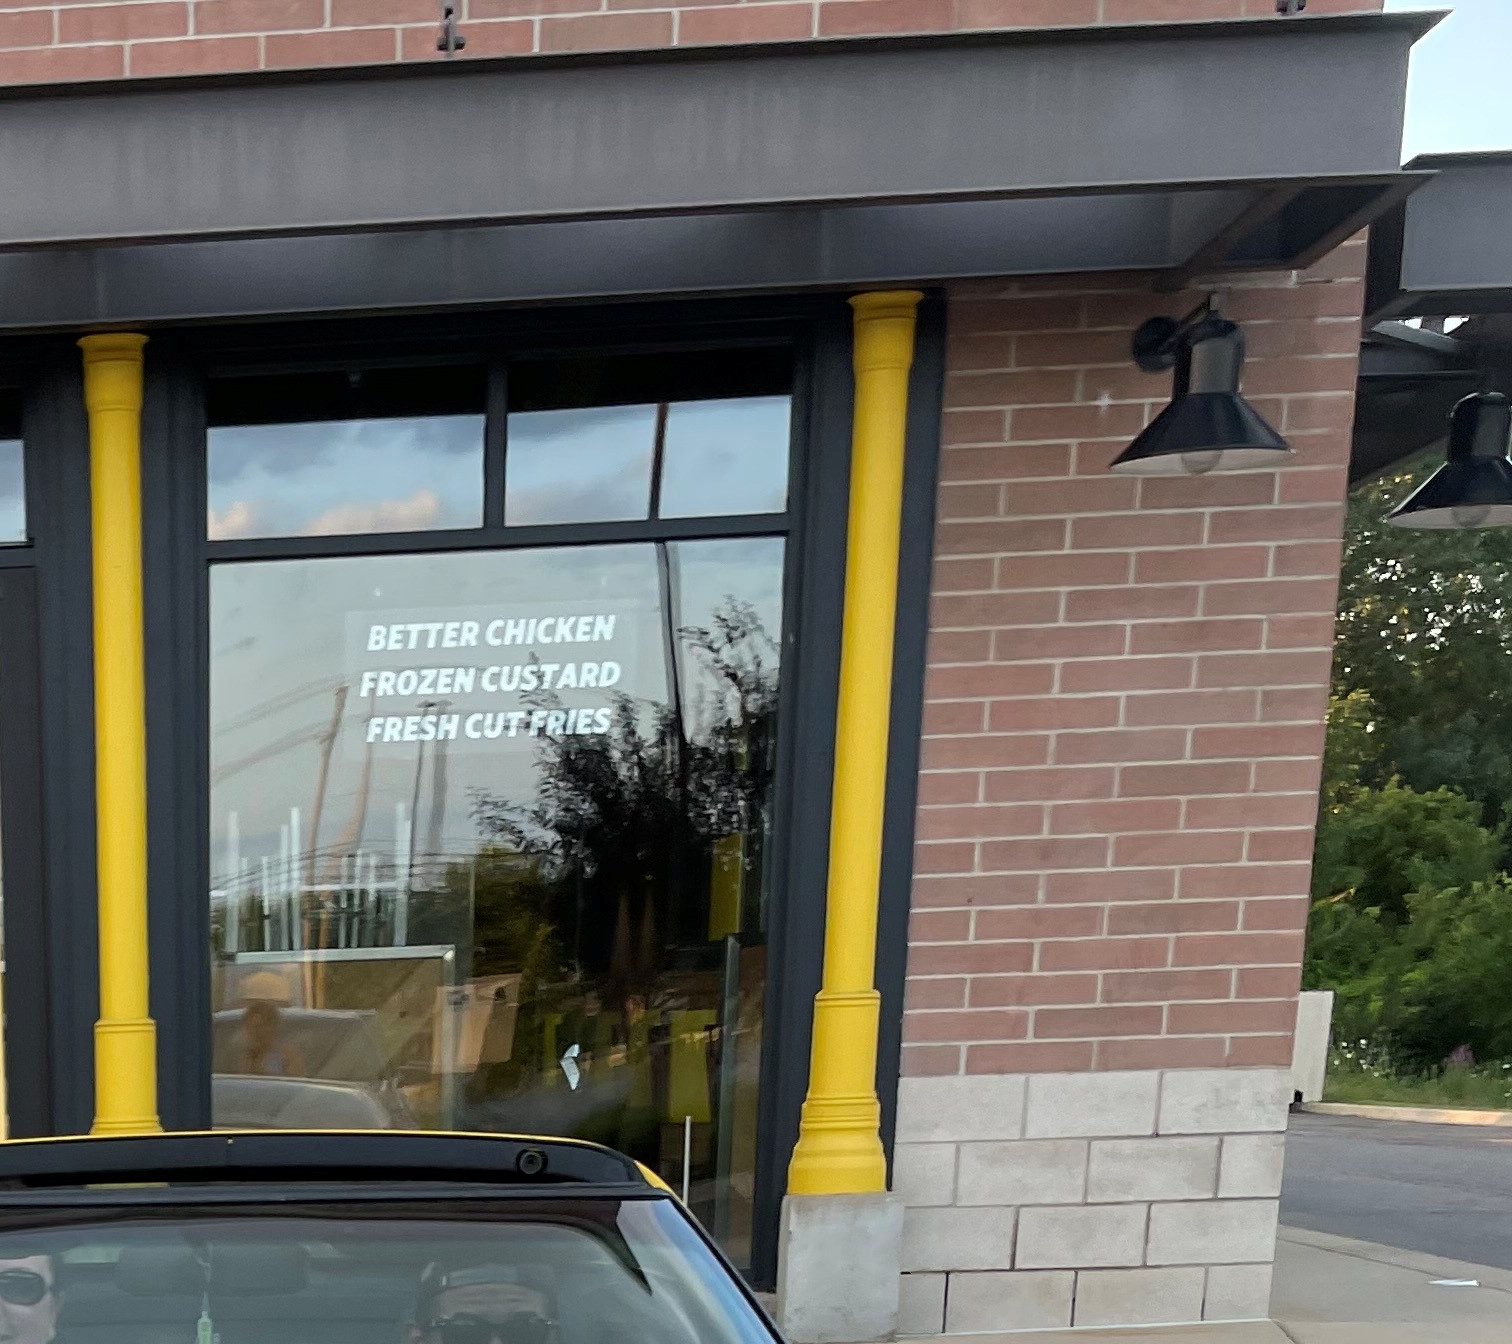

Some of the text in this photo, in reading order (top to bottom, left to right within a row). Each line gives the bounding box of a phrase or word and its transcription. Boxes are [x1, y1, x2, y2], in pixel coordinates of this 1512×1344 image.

[367, 614, 617, 650] BETTER CHICKEN
[359, 660, 622, 698] FROZEN CUSTARD
[365, 707, 612, 743] FRESH CUT FRIES
